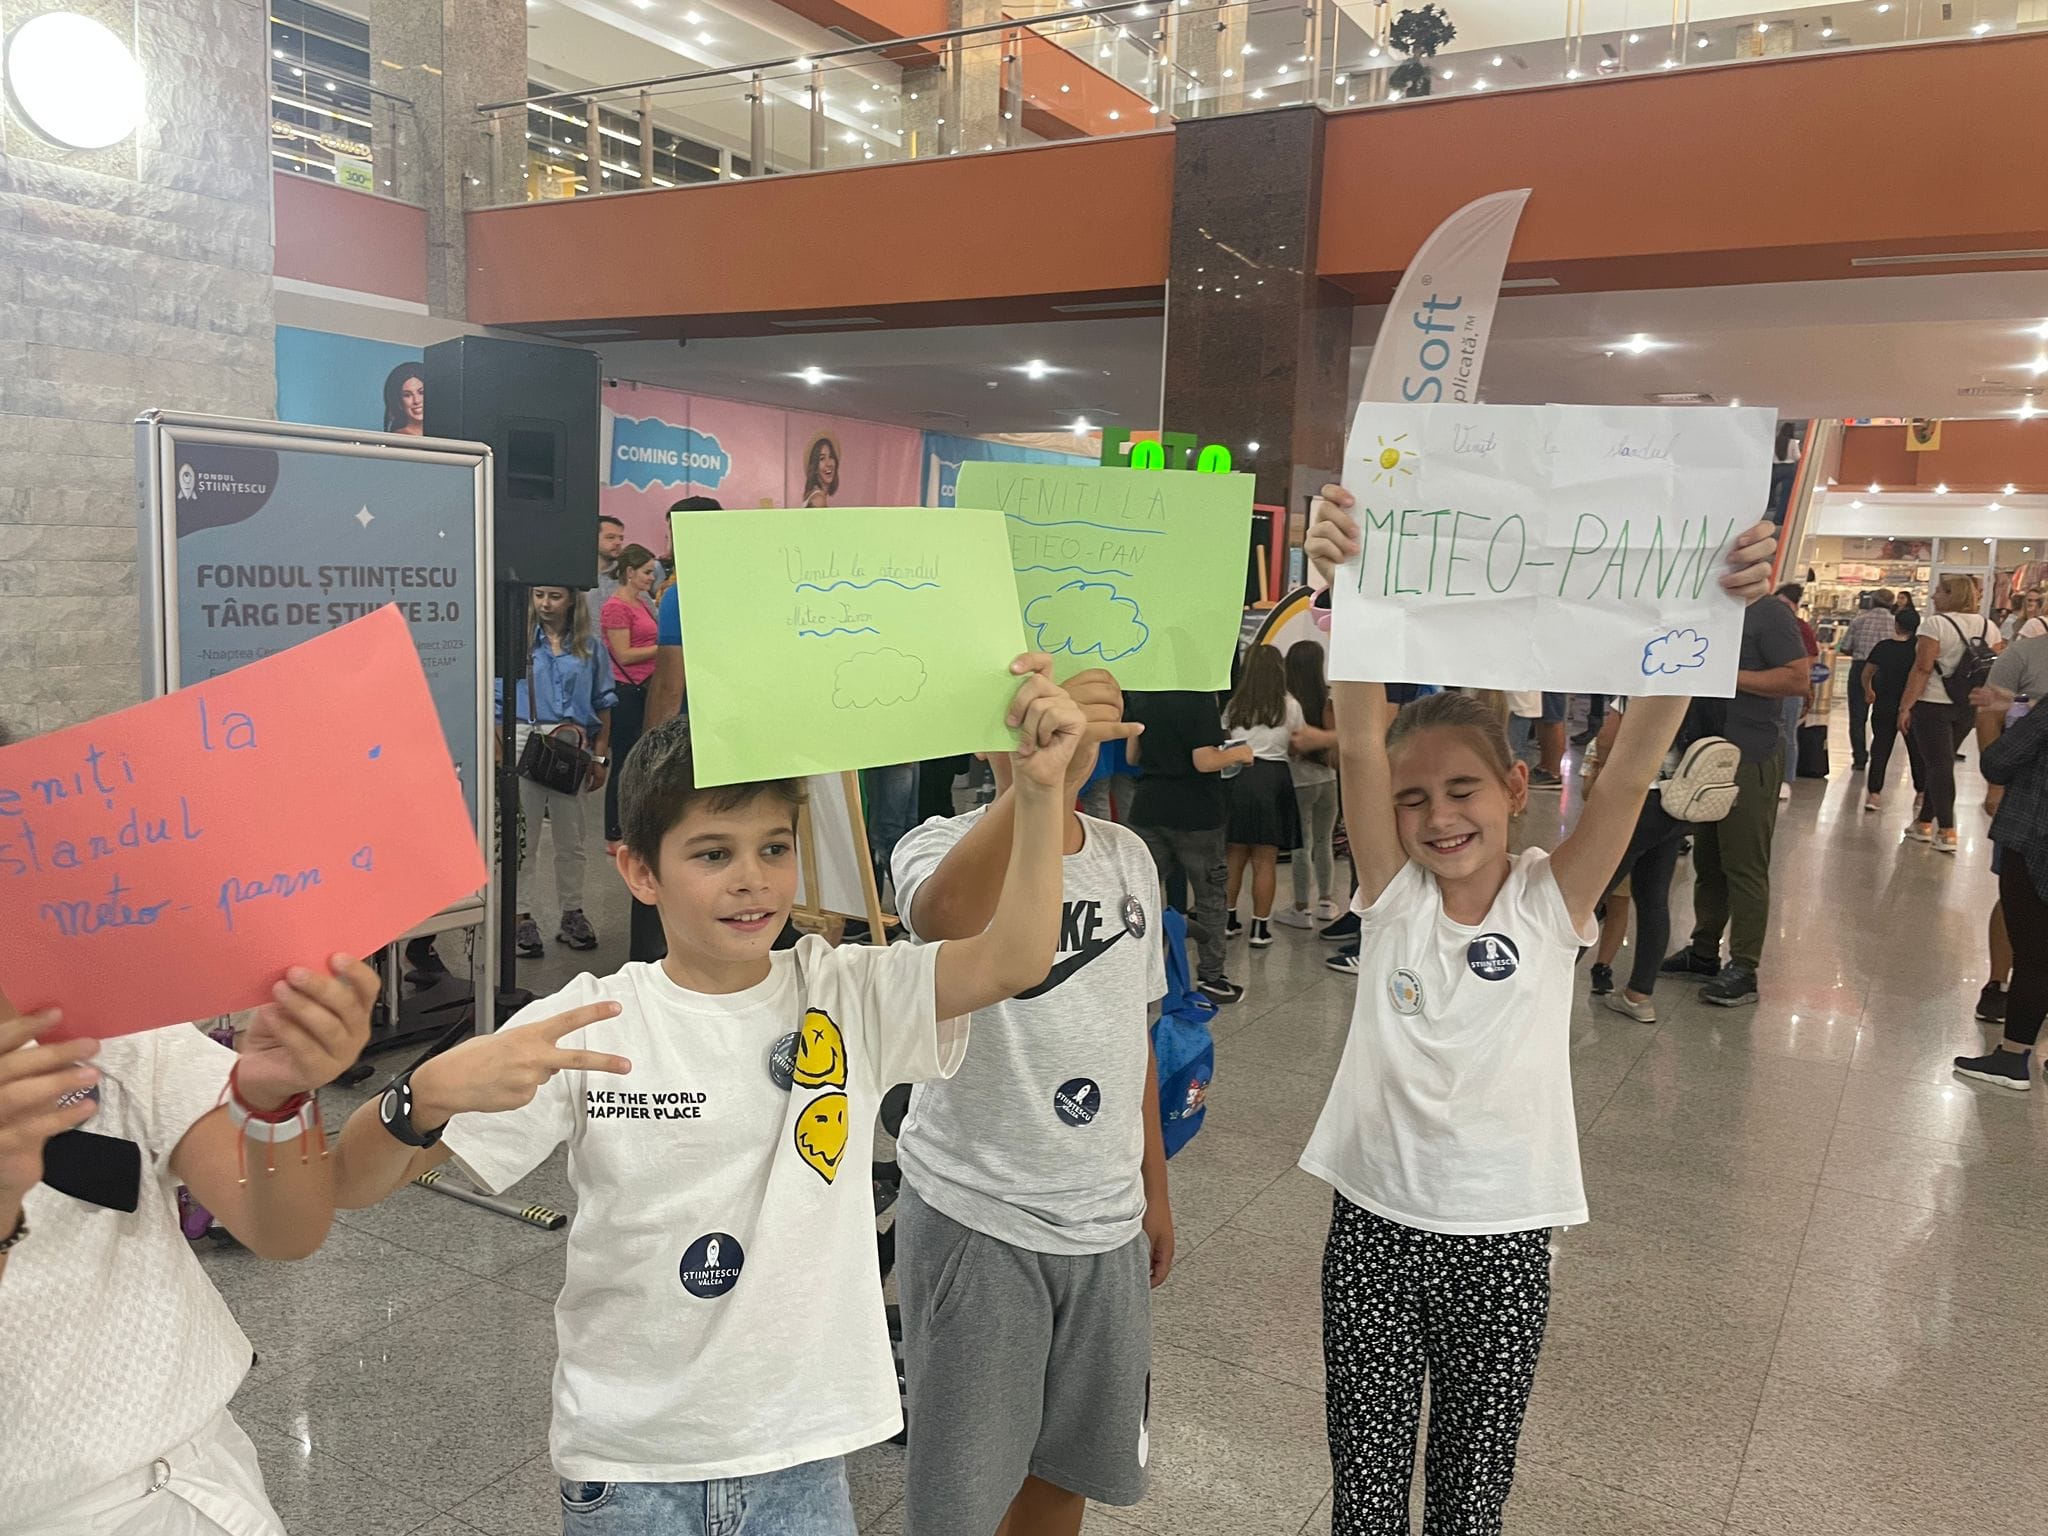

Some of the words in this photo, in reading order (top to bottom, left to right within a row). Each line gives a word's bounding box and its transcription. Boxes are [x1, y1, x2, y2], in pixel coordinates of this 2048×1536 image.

[617, 445, 678, 466] COMING
[681, 452, 721, 470] SOON
[199, 472, 235, 482] FONDUL
[1121, 486, 1166, 520] LA
[1012, 534, 1147, 564] ETEO-PAN
[1357, 508, 1735, 600] METEO-PANN
[197, 565, 312, 588] FONDUL
[318, 566, 457, 596] ȘTIINȚESCU
[202, 597, 278, 628] TÂRG
[287, 603, 320, 625] DE
[427, 601, 459, 621] 3.0
[0, 744, 134, 816] eniți
[198, 697, 257, 750] la
[586, 1091, 616, 1103] AKE
[619, 1093, 648, 1104] THE
[652, 1092, 707, 1105] WORLD
[587, 1106, 651, 1119] HAPPIER
[653, 1107, 701, 1120] PLACE
